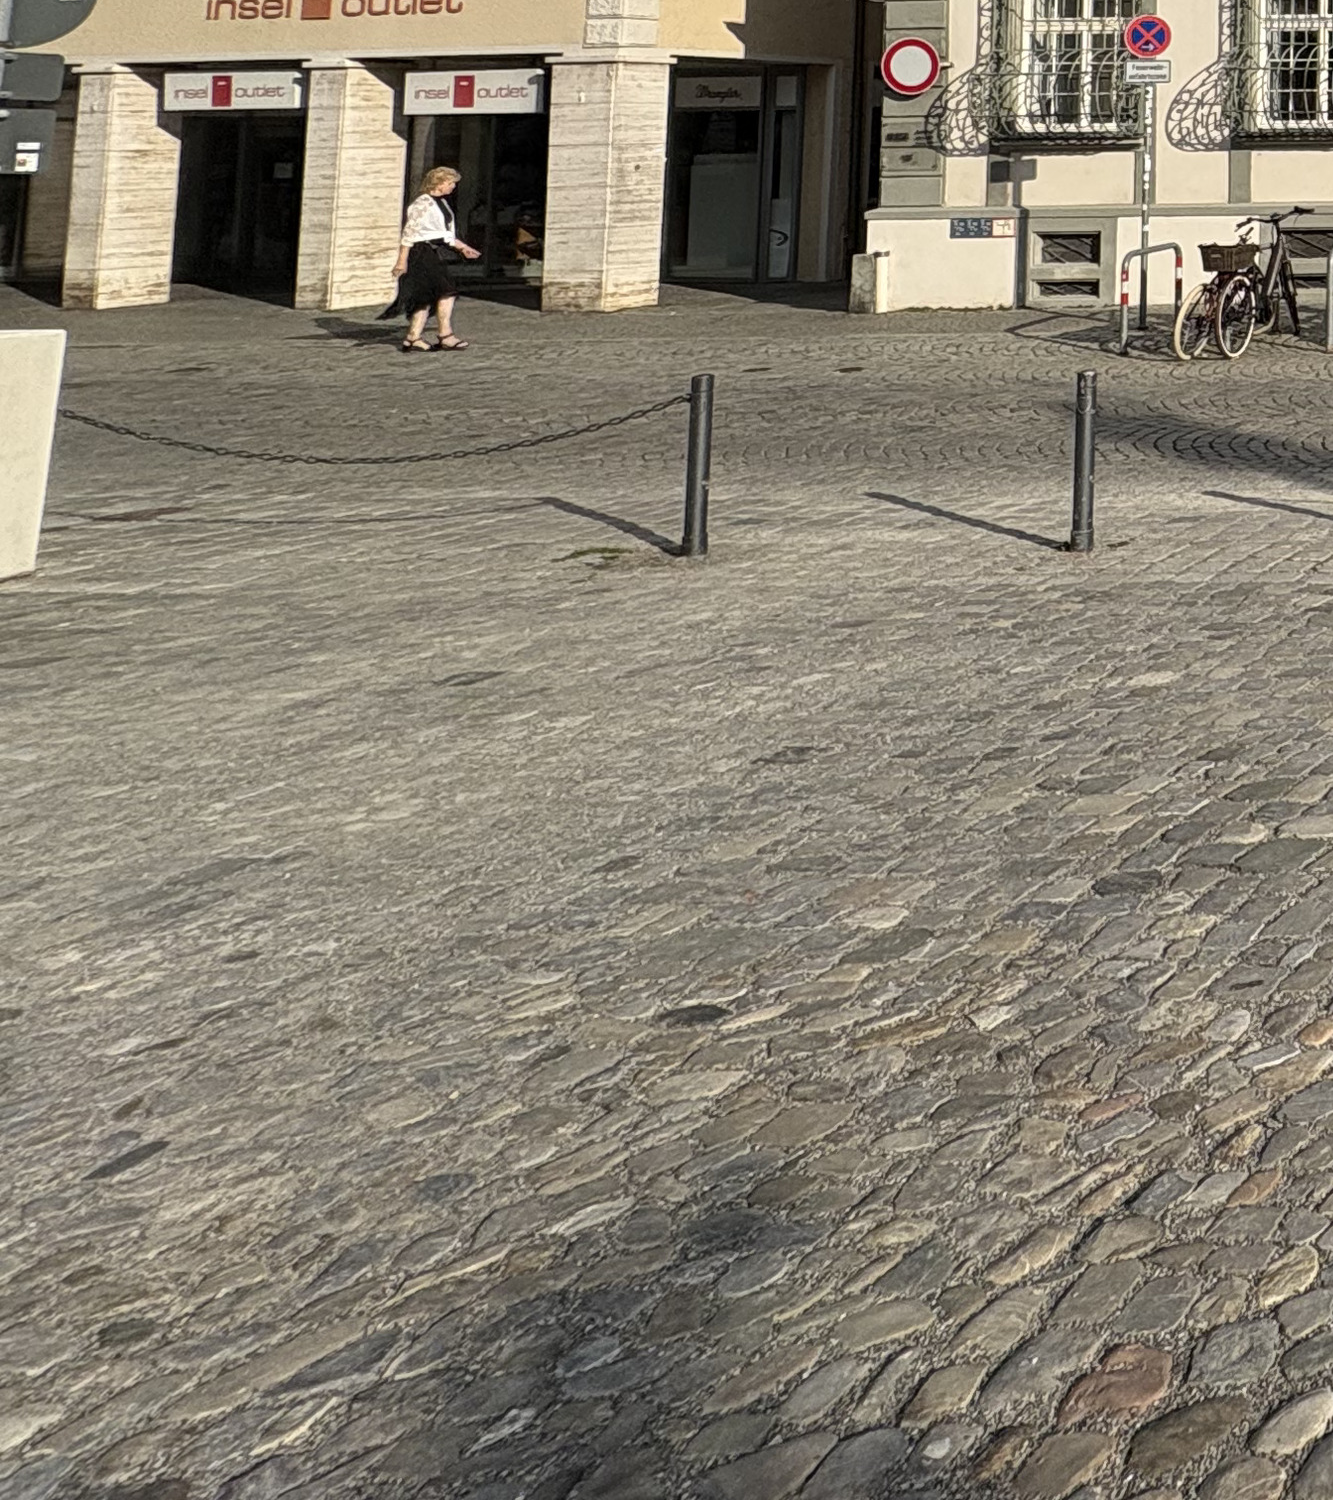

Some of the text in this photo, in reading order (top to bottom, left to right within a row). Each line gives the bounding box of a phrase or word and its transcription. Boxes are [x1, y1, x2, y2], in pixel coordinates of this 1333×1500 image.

[174, 84, 286, 100] insel outlet
[414, 84, 529, 100] insel outlet
